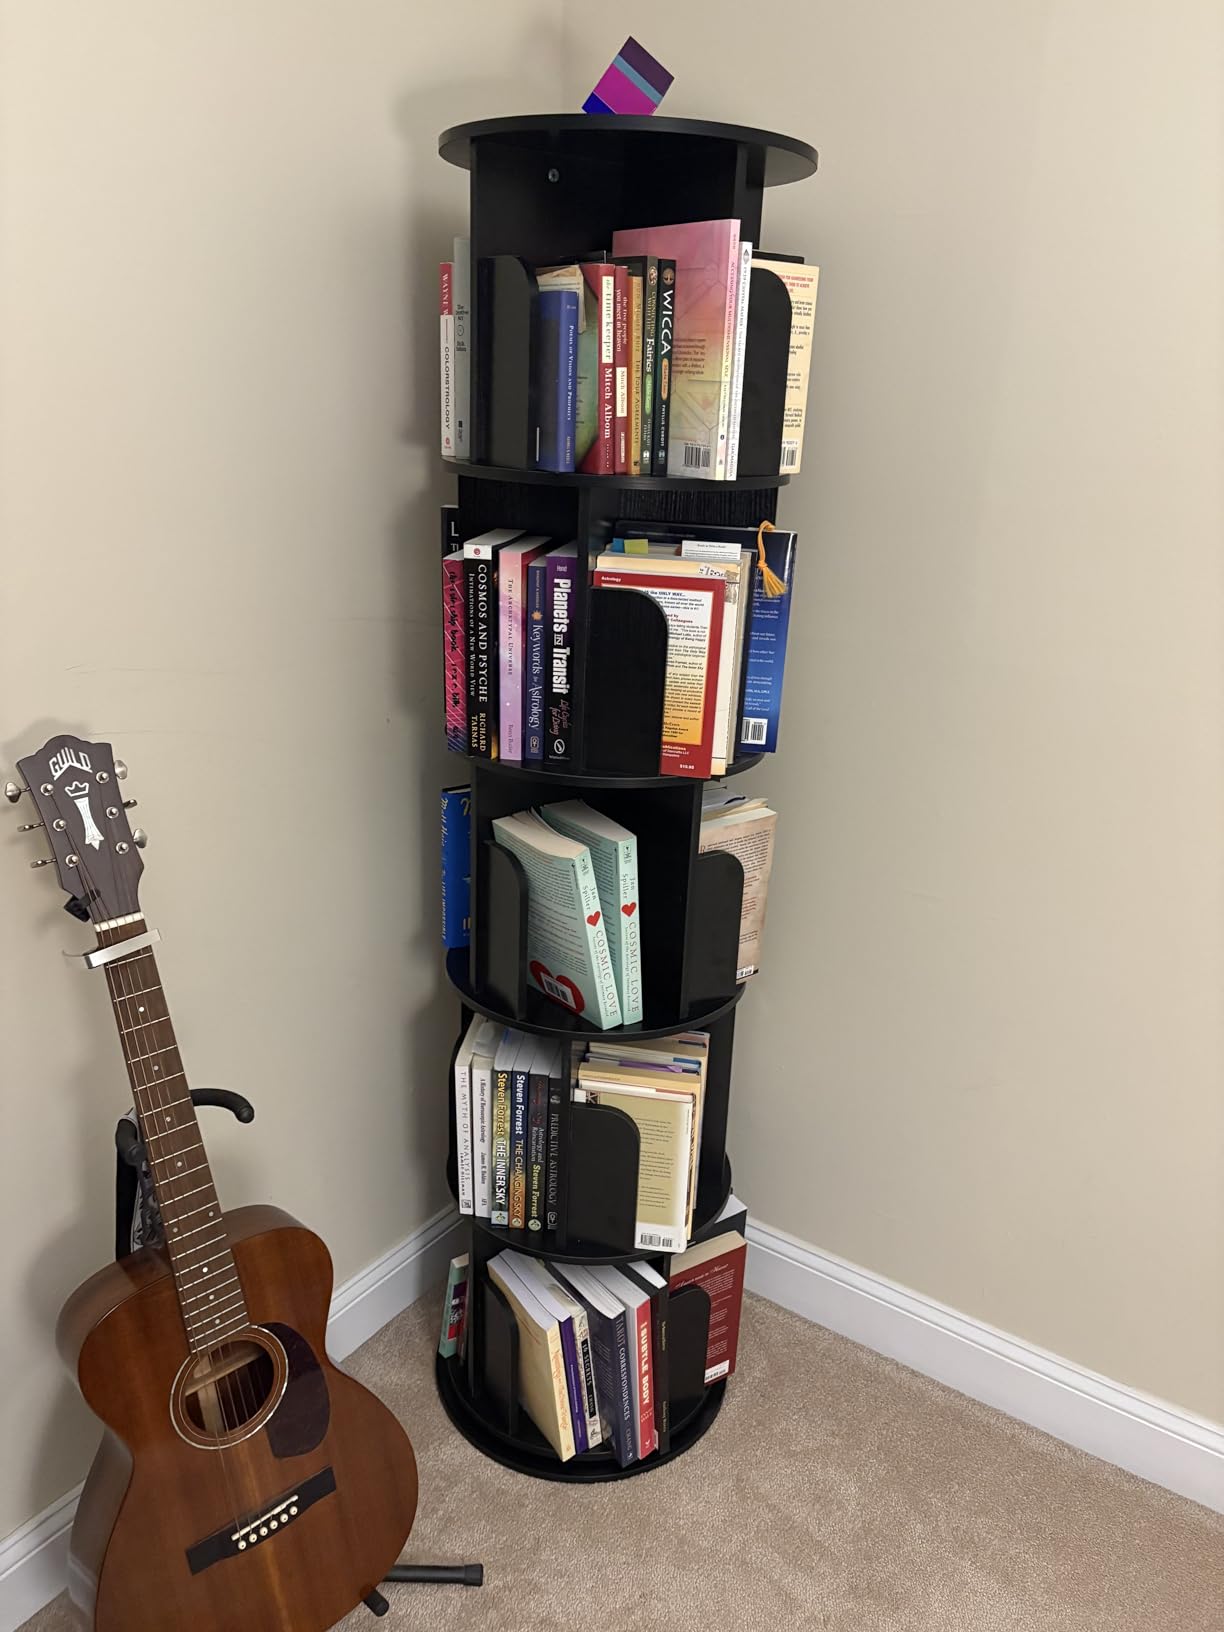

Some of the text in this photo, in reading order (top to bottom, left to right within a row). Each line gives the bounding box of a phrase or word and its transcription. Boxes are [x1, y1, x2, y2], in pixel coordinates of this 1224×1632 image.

[603, 321, 612, 360] keeper
[661, 290, 673, 355] WICCA
[645, 338, 655, 372] Fairies
[604, 368, 613, 399] Mitch
[604, 403, 613, 439] Albom
[451, 630, 459, 651] book
[469, 619, 475, 627] OF
[477, 564, 488, 702] COSMOS AND PSYCHE
[552, 578, 571, 694] Planets IN Transit
[531, 624, 543, 674] Keywords
[528, 683, 543, 729] Astrology
[557, 699, 570, 728] Life Cycles
[479, 712, 487, 752] RICHARD
[48, 746, 93, 780] GUILD
[582, 885, 591, 910] Spiller
[589, 887, 597, 900] Jan
[621, 873, 629, 899] Spiller
[596, 930, 618, 1017] COSMIC LOVE
[628, 921, 640, 1013] COSMIC LOVE
[461, 1092, 469, 1118] MYTH
[496, 1073, 508, 1135] Steven Forrest
[515, 1075, 525, 1134] Steven Forrest
[462, 1123, 469, 1133] OF
[530, 1126, 538, 1162] Reincarnation
[536, 1126, 545, 1152] Astrology
[463, 1138, 471, 1180] ANALYSIS
[495, 1139, 506, 1205] THE INNER SKY
[513, 1139, 524, 1218] THE CHANGING SKY
[548, 1113, 559, 1206] PREDICTIVE ASTROLOGY
[531, 1164, 541, 1217] Steven Forrest
[615, 1315, 631, 1421] TAROT CORRESPONDENCES
[640, 1327, 649, 1373] SUBTLE
[583, 1354, 592, 1386] SECRETS
[642, 1374, 650, 1405] BODY
